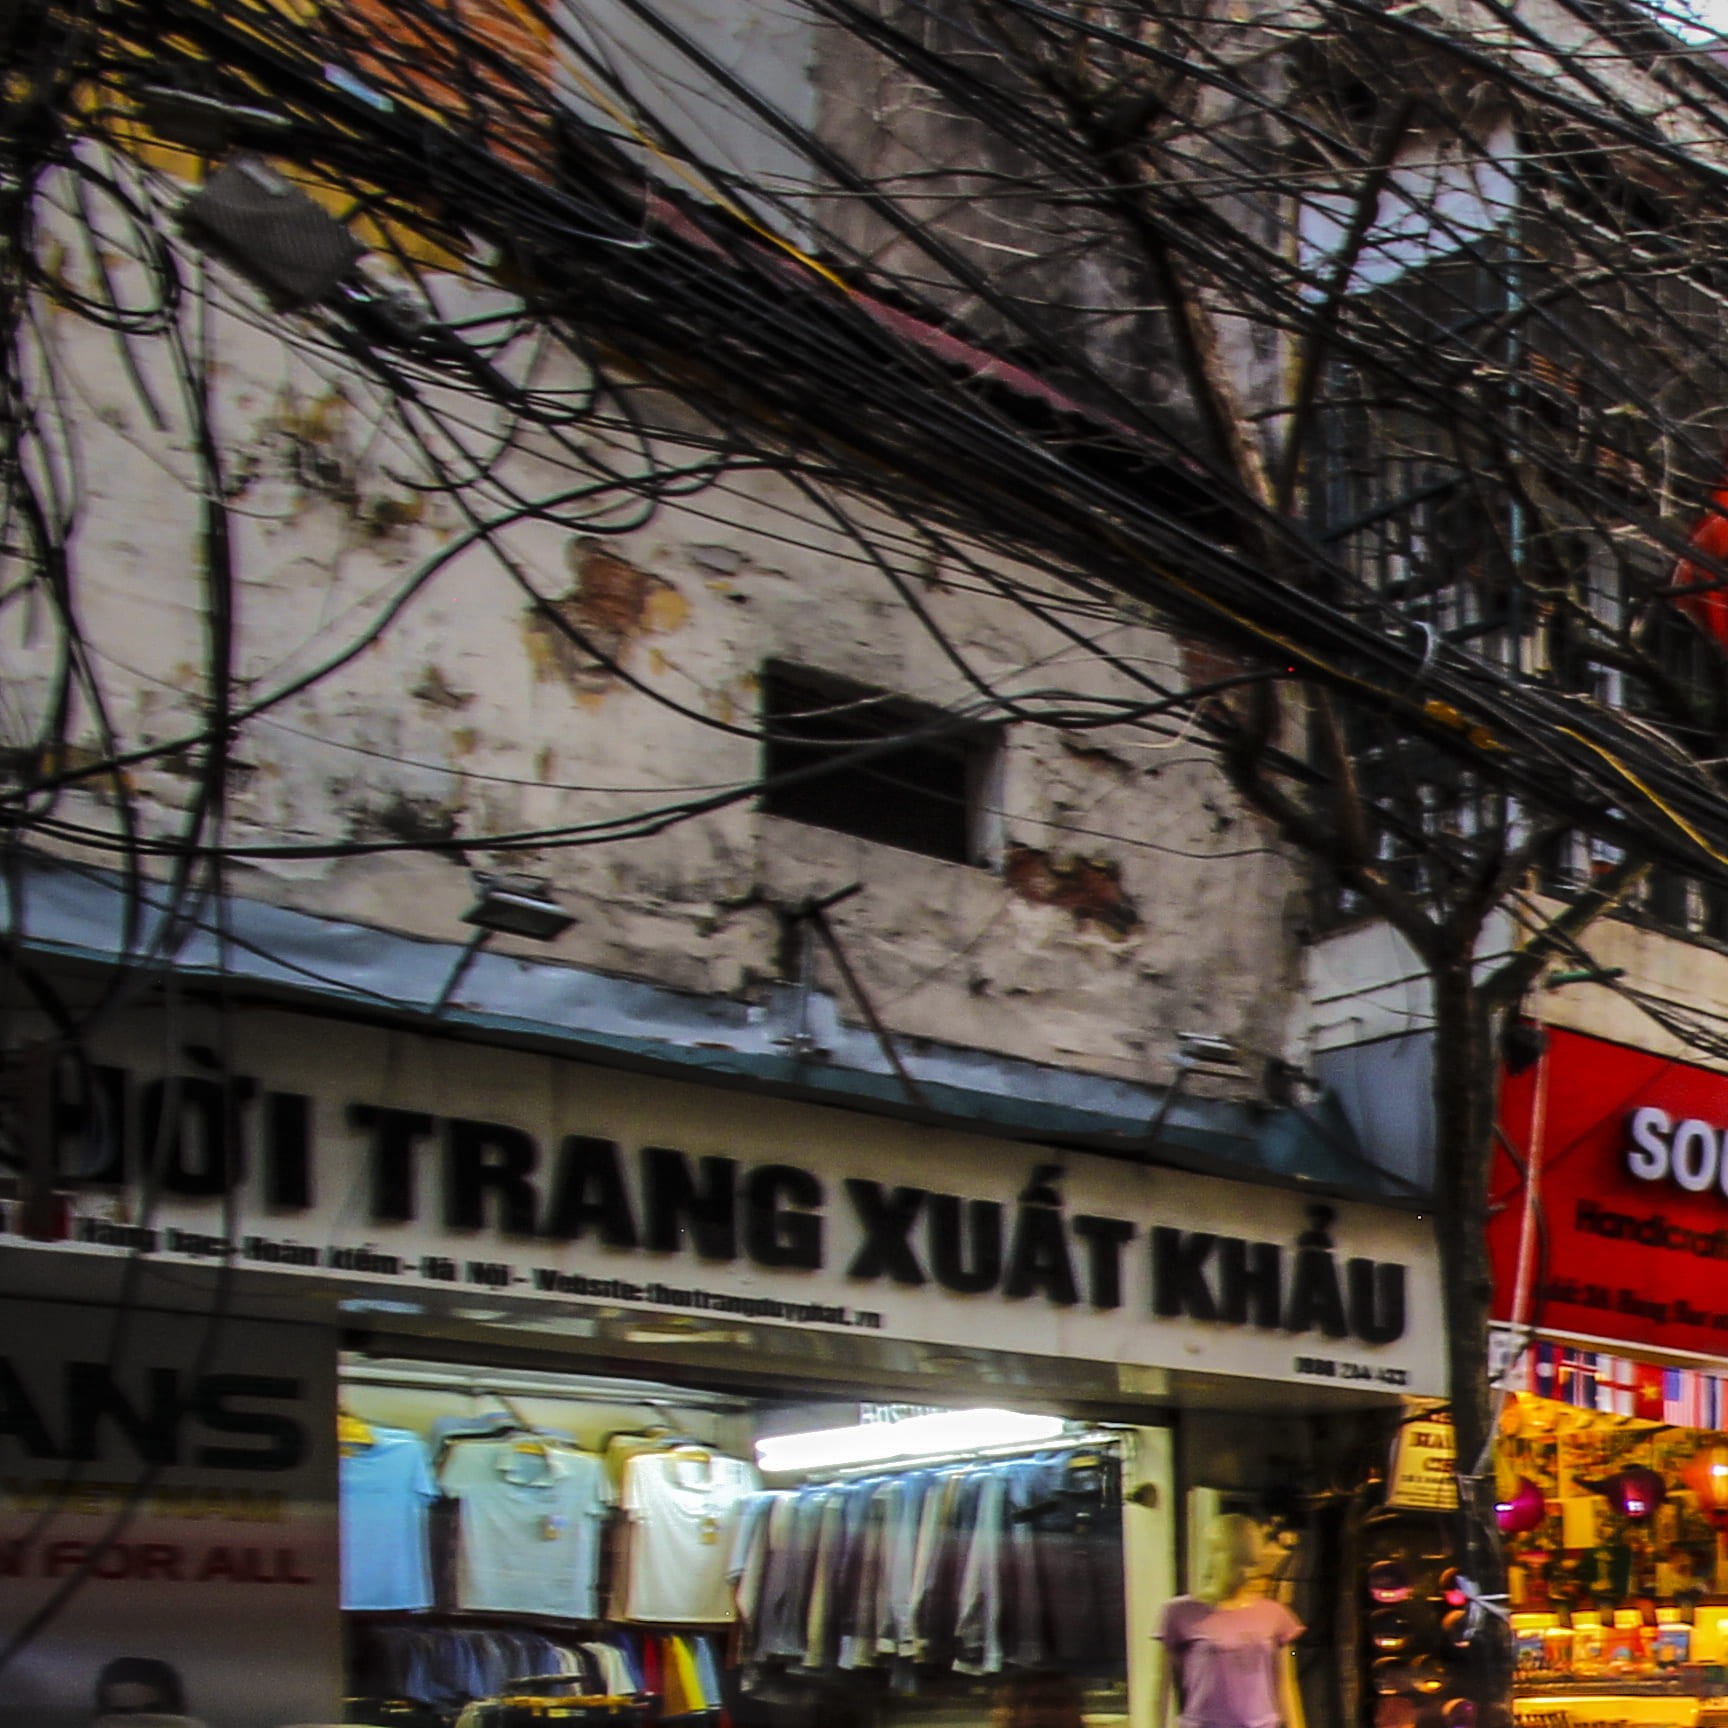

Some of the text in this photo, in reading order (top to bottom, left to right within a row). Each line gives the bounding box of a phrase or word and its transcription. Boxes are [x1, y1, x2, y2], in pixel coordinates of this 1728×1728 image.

[345, 1102, 825, 1270] TRANG
[845, 1164, 1135, 1311] XUẤT
[1150, 1204, 1407, 1345] KHẨU
[45, 1539, 189, 1583] FOR
[196, 1546, 315, 1586] ALL
